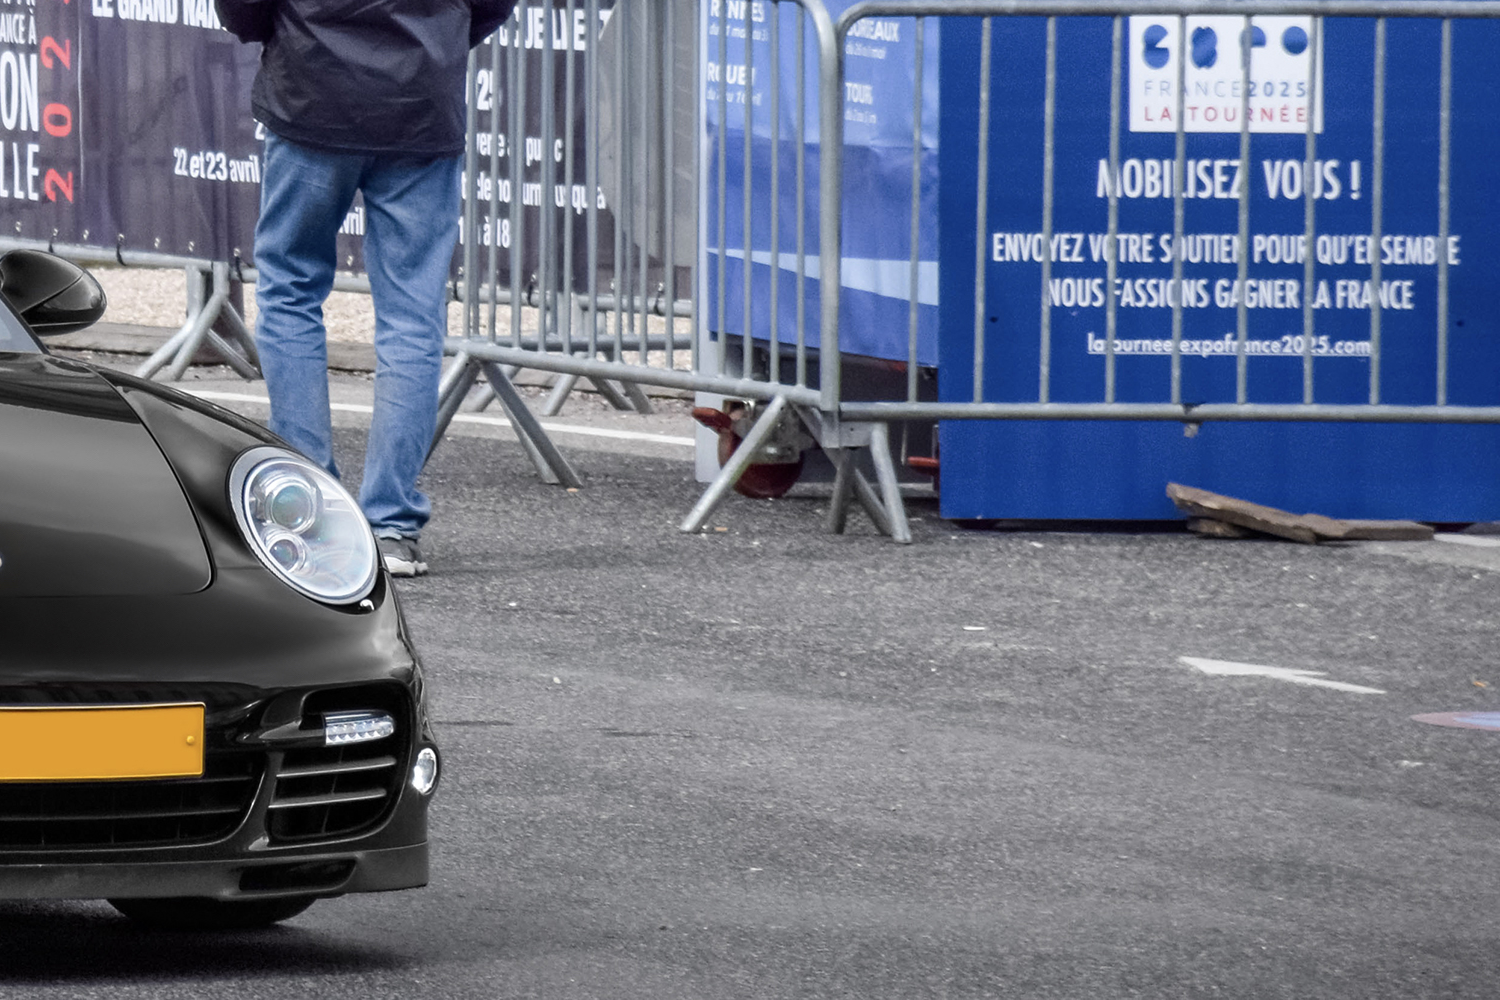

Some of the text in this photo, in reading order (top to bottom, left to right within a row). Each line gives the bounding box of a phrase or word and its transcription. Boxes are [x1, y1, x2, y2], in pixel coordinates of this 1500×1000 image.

[28, 8, 38, 46] À
[189, 151, 205, 179] et
[206, 151, 228, 181] 23
[229, 155, 260, 183] avril
[1263, 160, 1341, 200] VOUS
[1316, 234, 1461, 266] QU'ESEMBE
